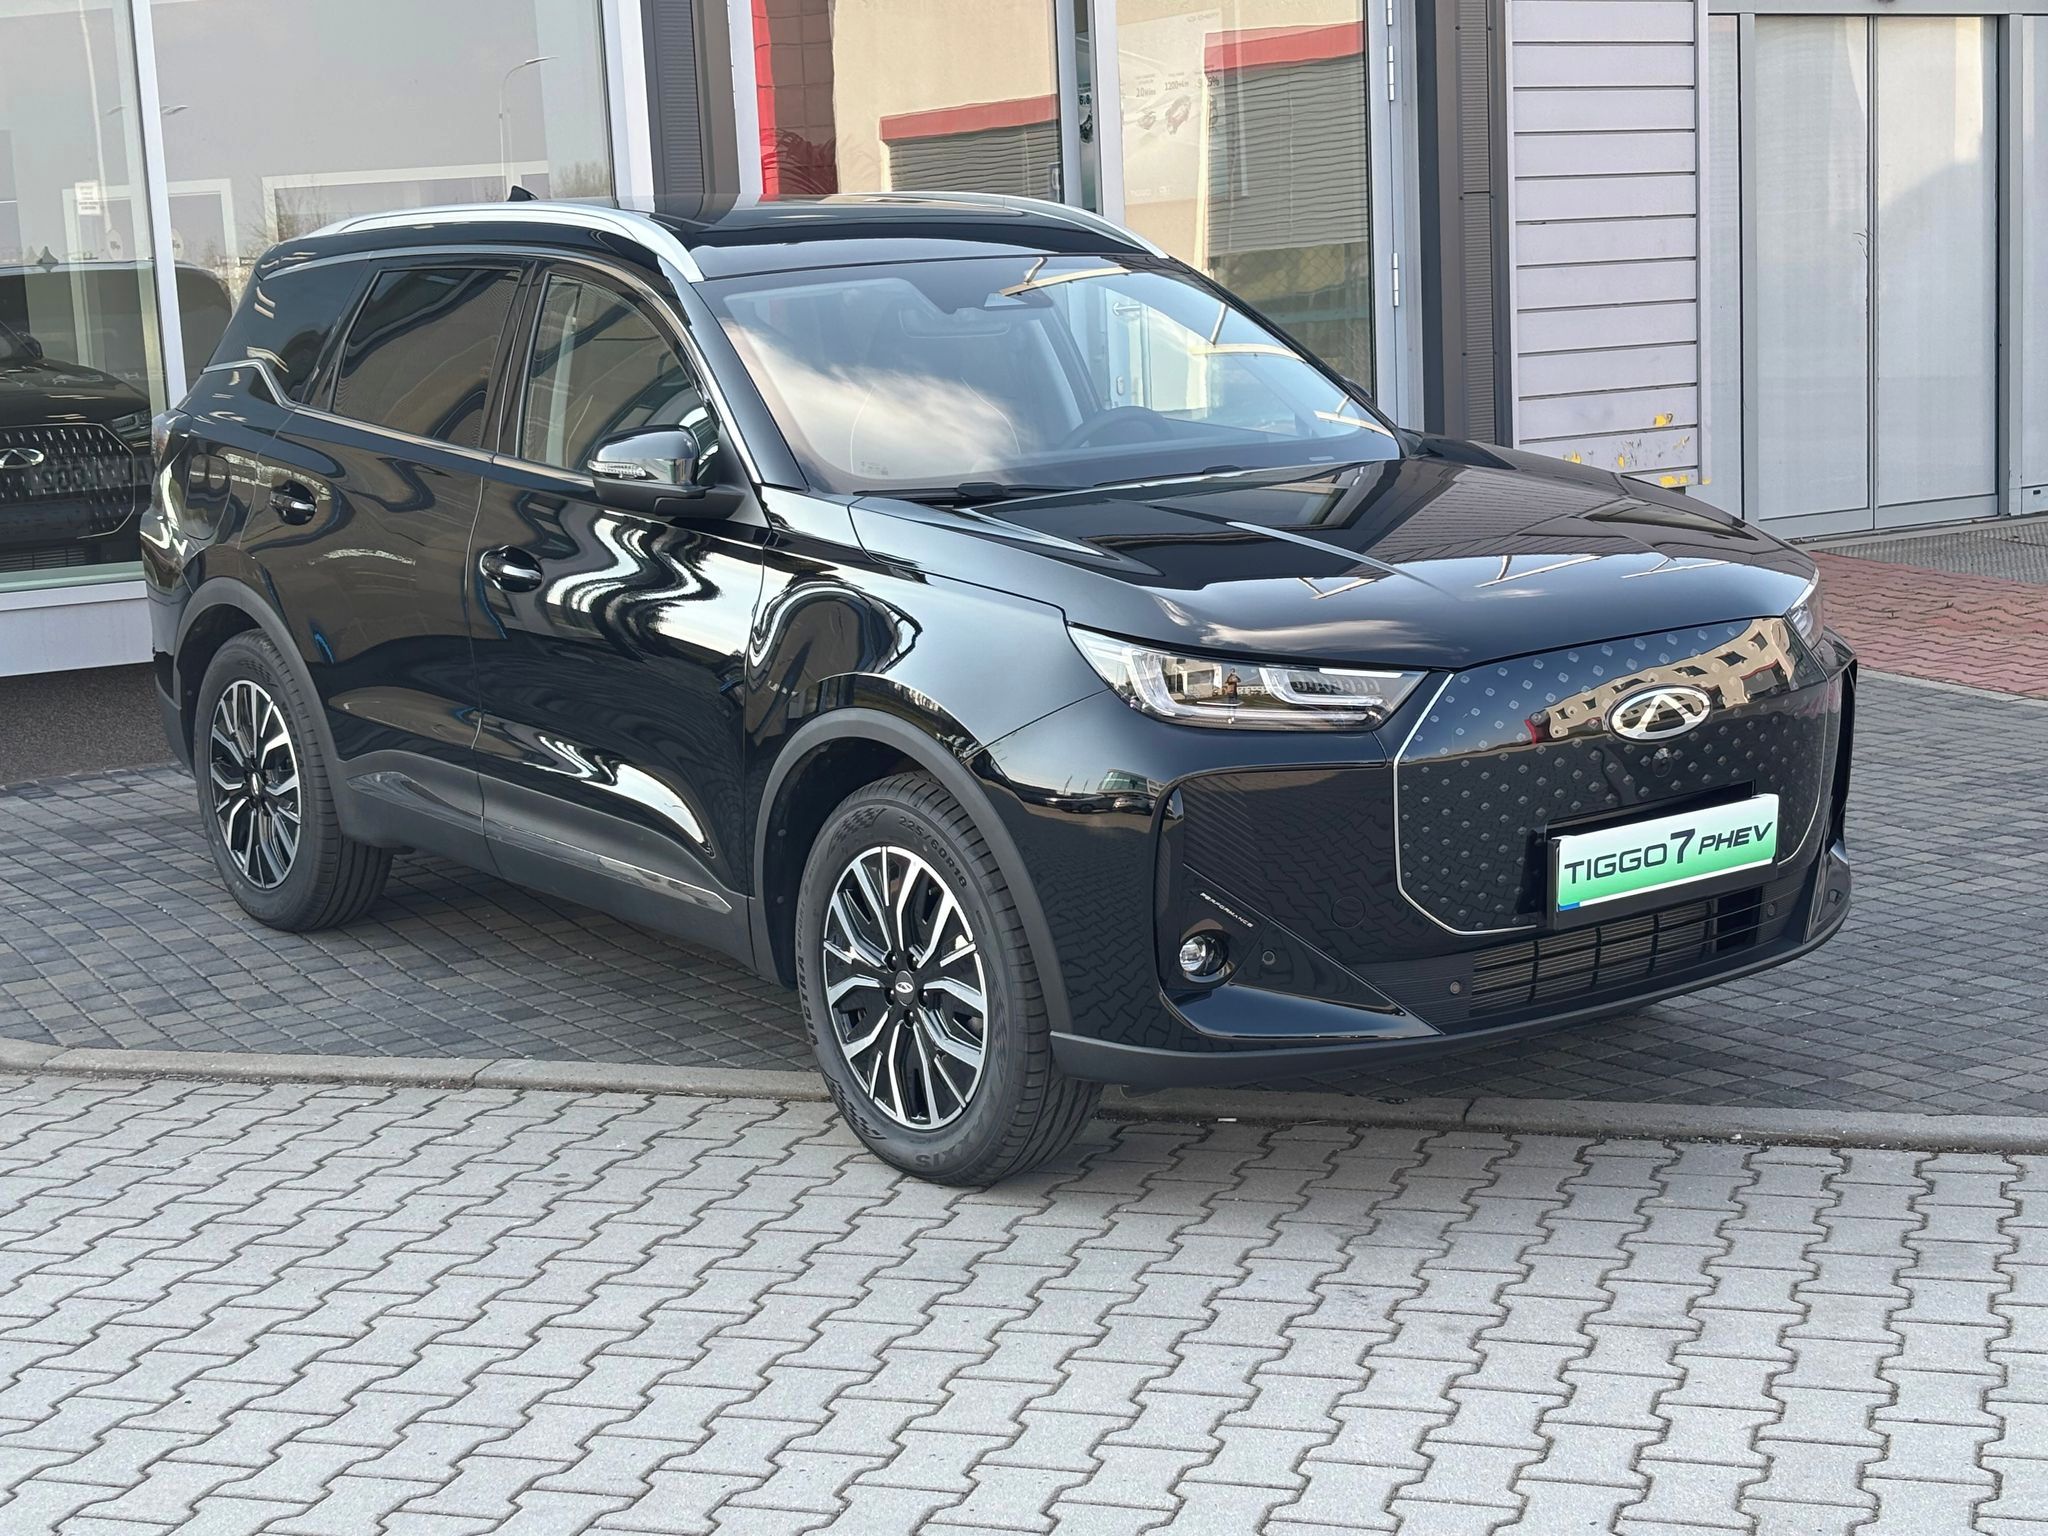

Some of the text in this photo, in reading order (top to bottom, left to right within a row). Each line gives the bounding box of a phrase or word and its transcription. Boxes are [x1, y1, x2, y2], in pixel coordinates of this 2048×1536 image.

[897, 816, 968, 888] 225/60R18
[1564, 821, 1774, 884] TIGGO 7 PHEV
